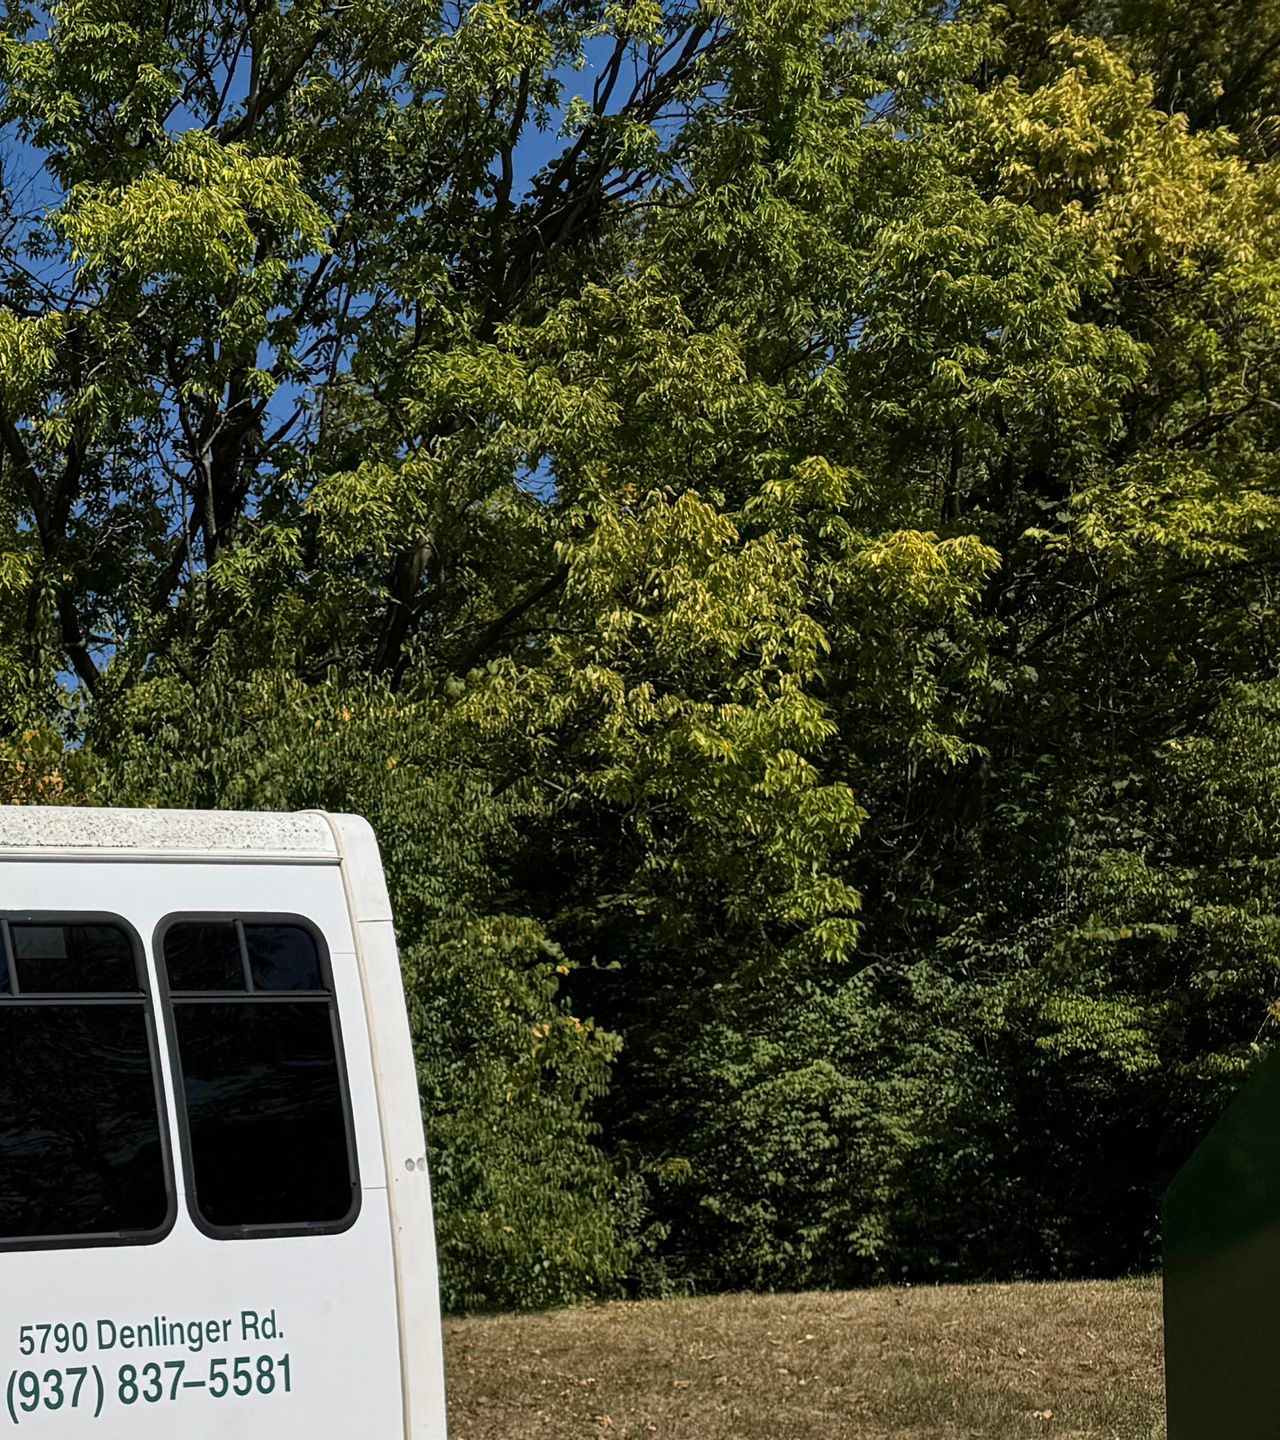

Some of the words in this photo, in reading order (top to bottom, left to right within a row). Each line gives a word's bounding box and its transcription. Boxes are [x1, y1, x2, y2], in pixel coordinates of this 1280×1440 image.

[19, 1322, 88, 1356] 5790
[96, 1316, 233, 1352] Denlinger
[240, 1309, 285, 1341] Rd.
[6, 1365, 106, 1424] (937)
